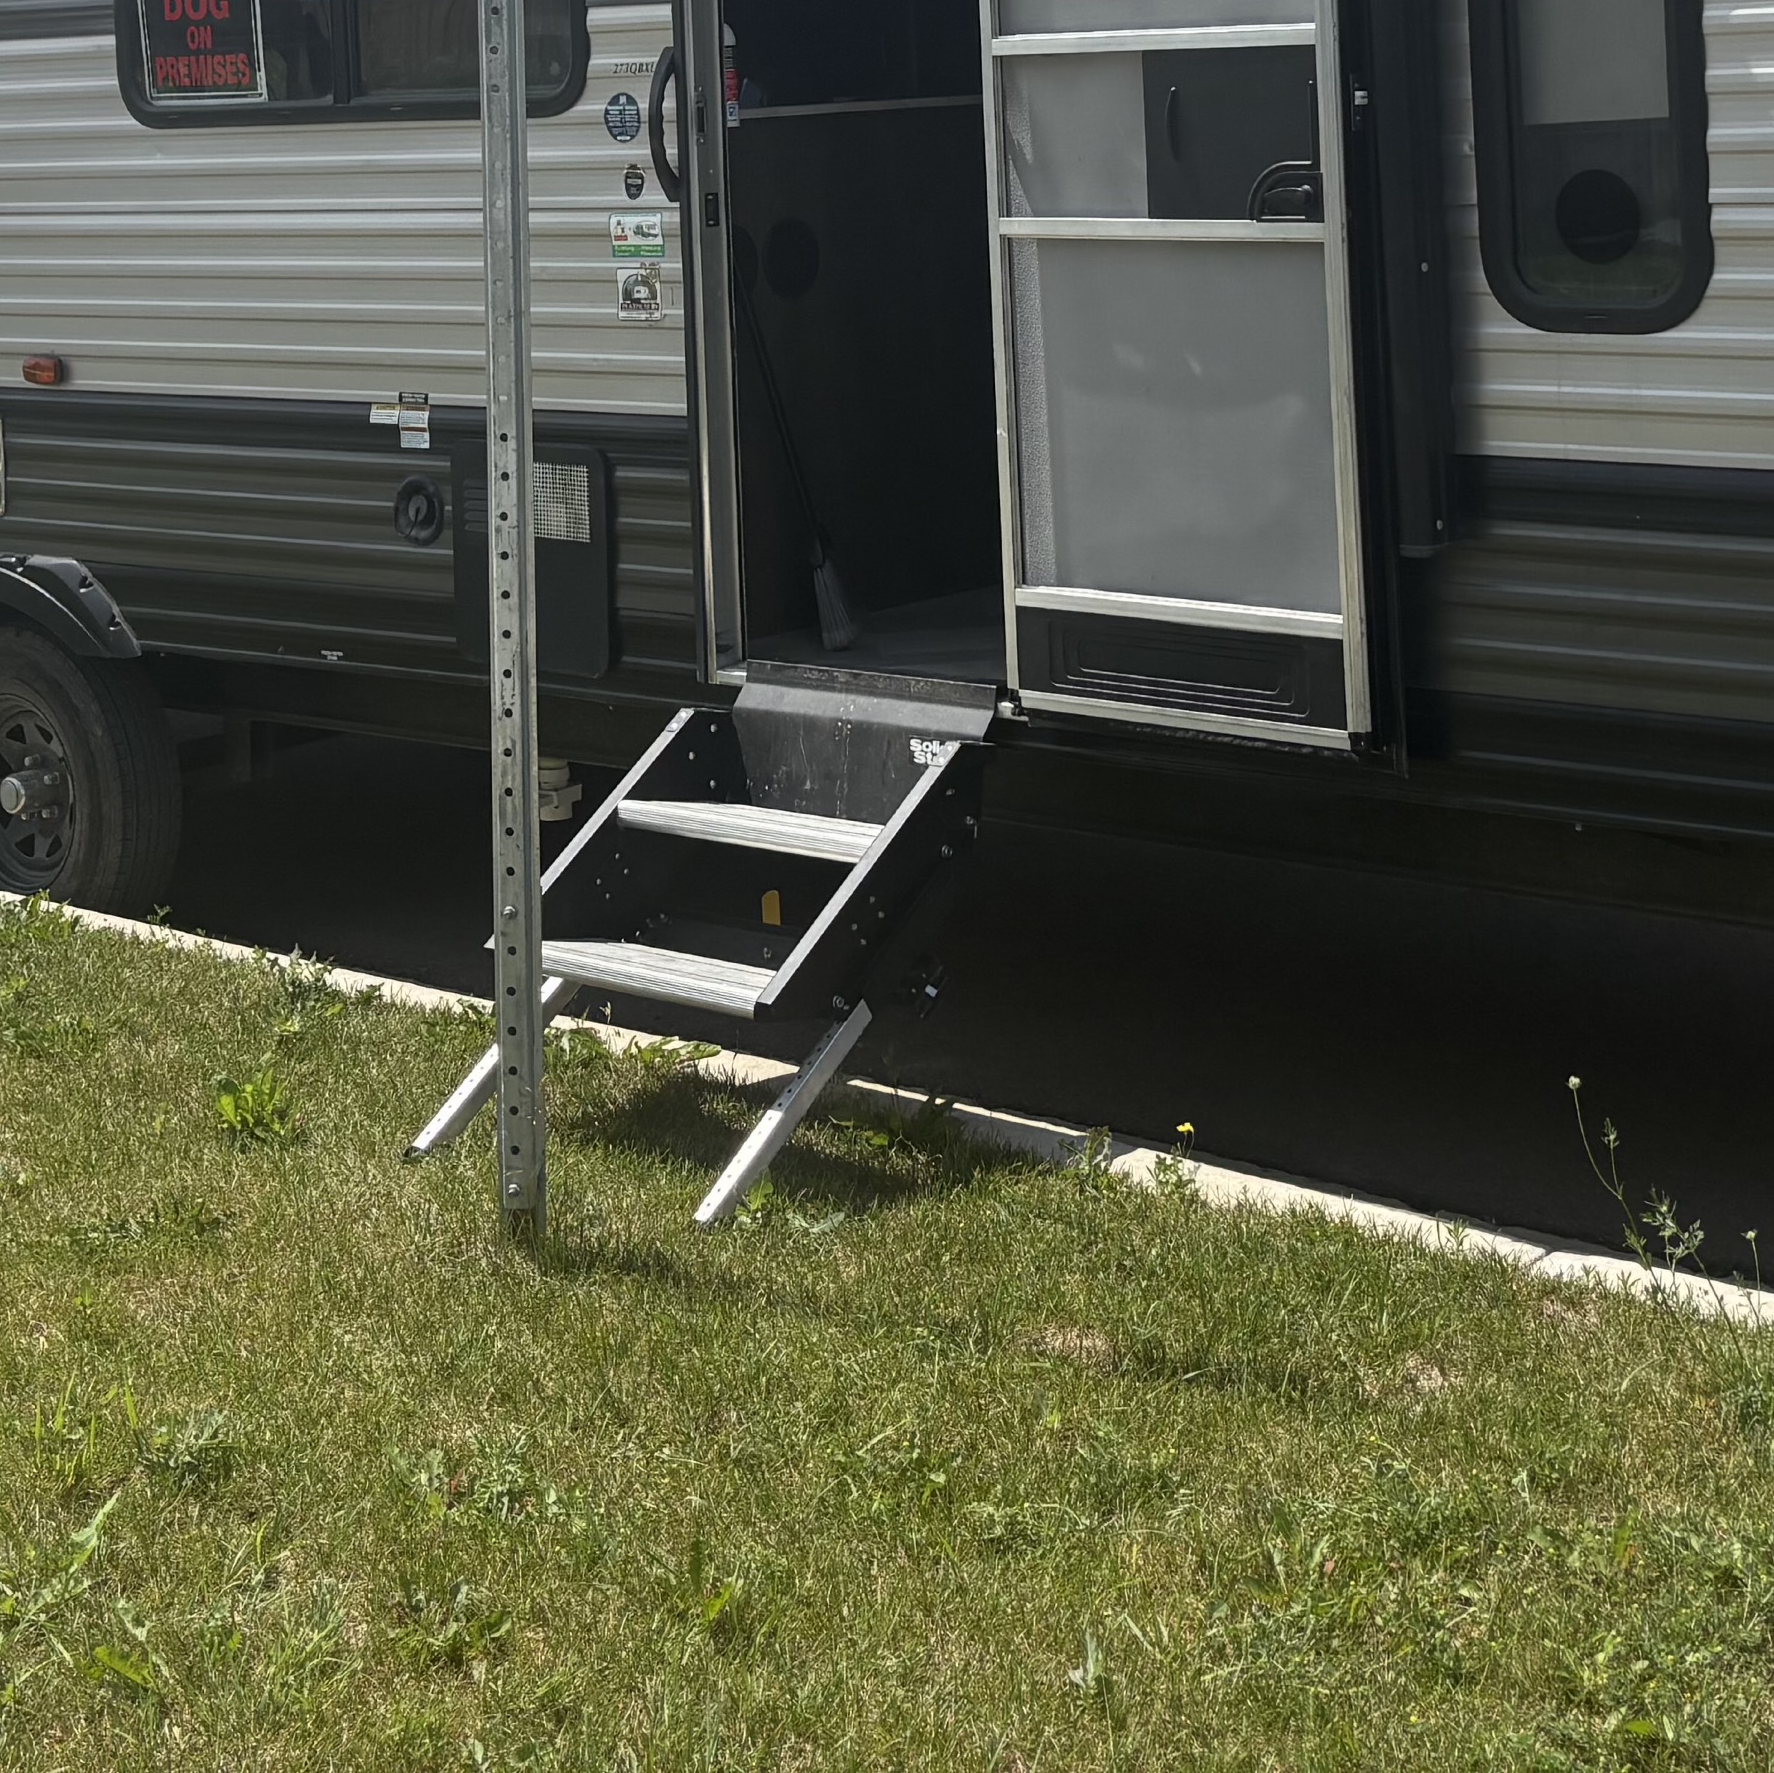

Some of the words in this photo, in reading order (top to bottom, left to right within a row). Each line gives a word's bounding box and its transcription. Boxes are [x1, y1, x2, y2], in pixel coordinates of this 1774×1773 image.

[186, 25, 213, 51] ON
[155, 53, 252, 88] PREMISES
[909, 738, 945, 754] Soli
